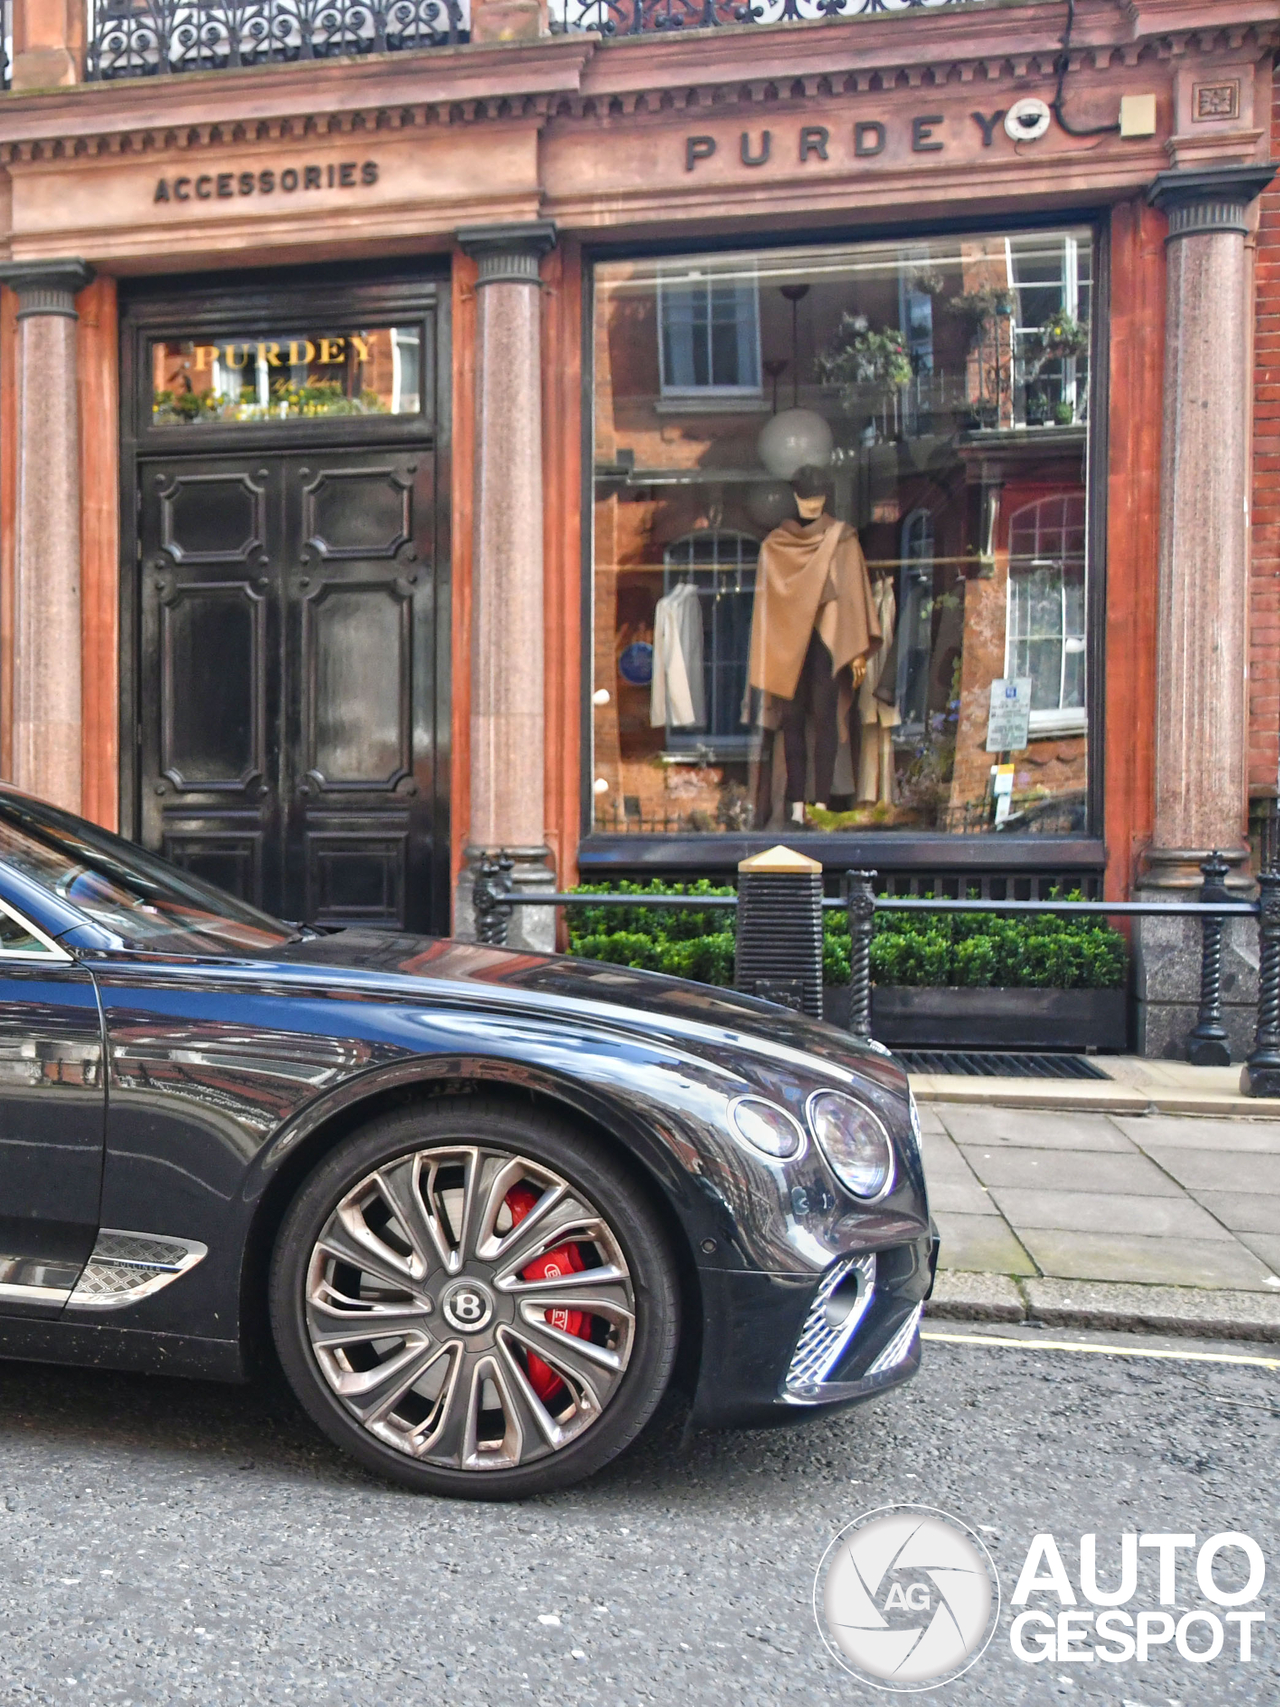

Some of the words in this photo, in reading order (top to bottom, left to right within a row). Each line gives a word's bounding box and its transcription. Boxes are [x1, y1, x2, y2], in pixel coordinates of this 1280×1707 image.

[685, 110, 1007, 170] PURDEY
[154, 160, 380, 203] ACCESSORIES
[194, 335, 379, 371] PURDEY
[113, 1260, 162, 1273] MULLINER
[455, 1293, 481, 1319] B
